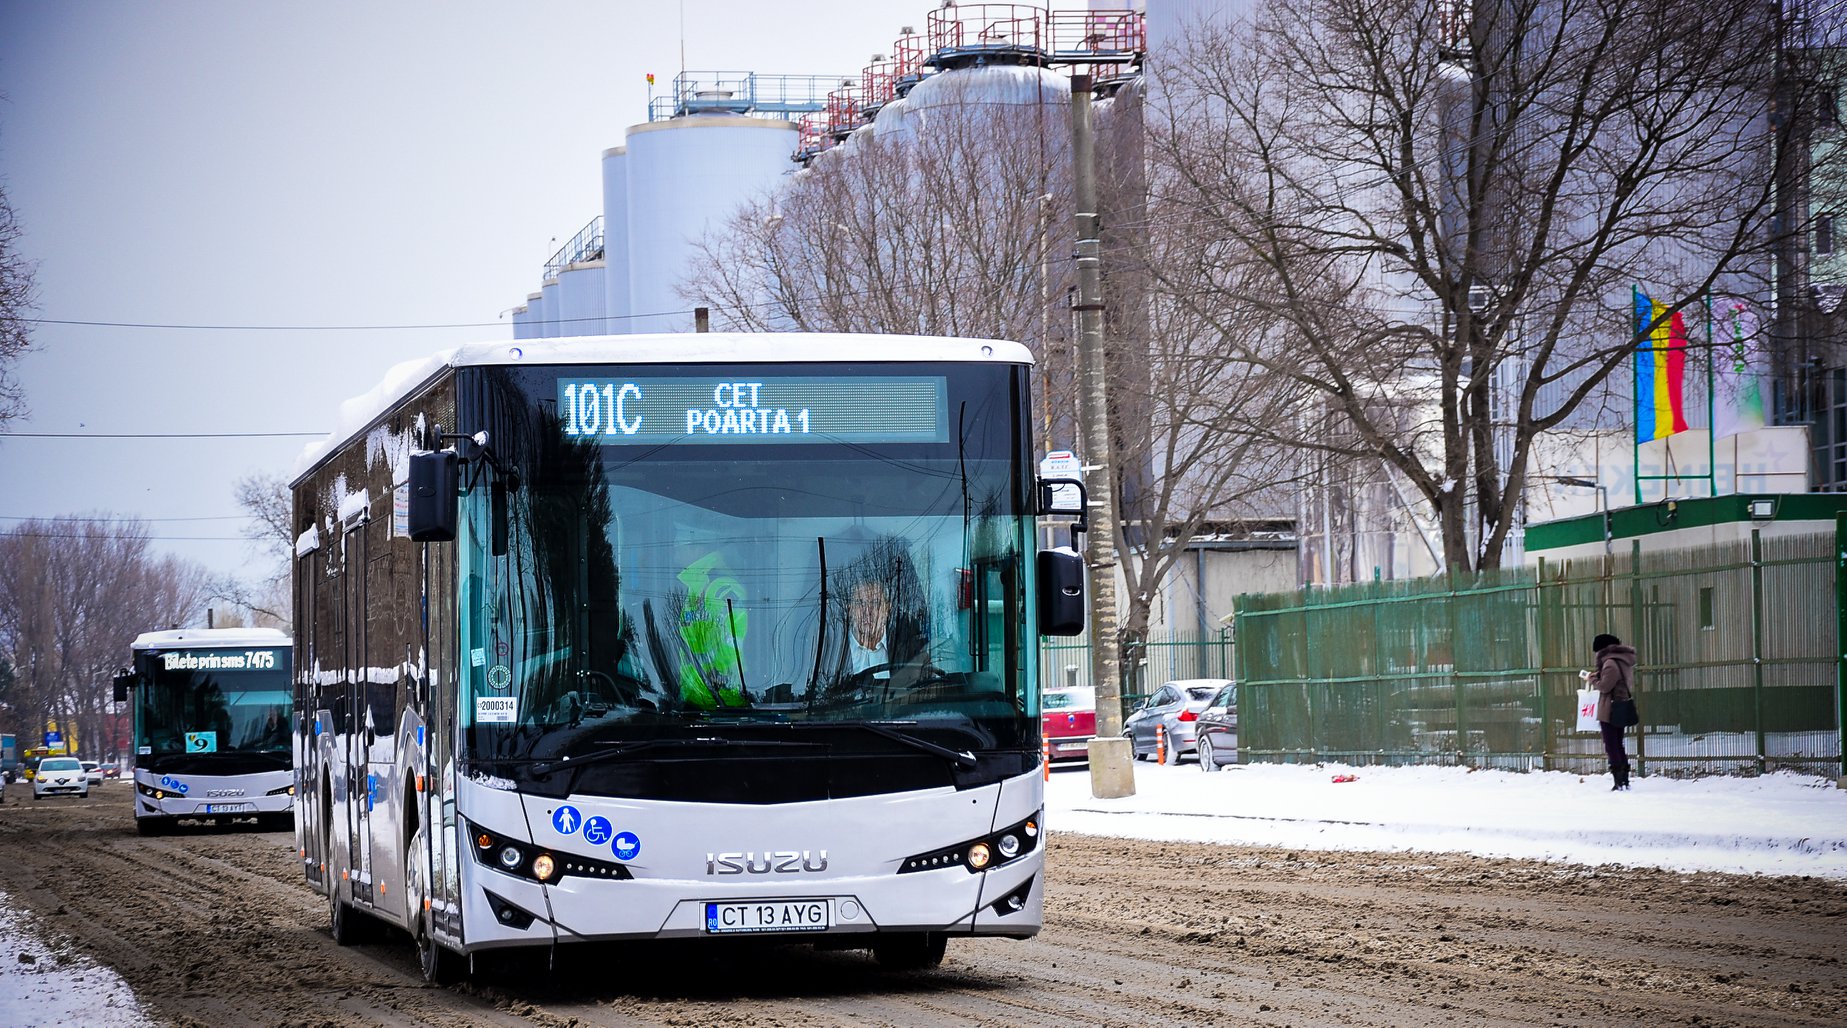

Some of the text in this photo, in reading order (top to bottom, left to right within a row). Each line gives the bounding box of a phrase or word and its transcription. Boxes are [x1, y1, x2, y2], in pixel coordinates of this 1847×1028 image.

[713, 382, 763, 408] CET
[564, 382, 643, 435] 101C
[686, 408, 811, 435] POARTA 1
[164, 651, 274, 670] Bilete prin sms 7475
[481, 700, 514, 711] 2000314
[194, 739, 209, 752] 9
[206, 788, 245, 797] ISUZU
[706, 849, 828, 875] ISUZU
[722, 904, 822, 926] CT 13 AYG
